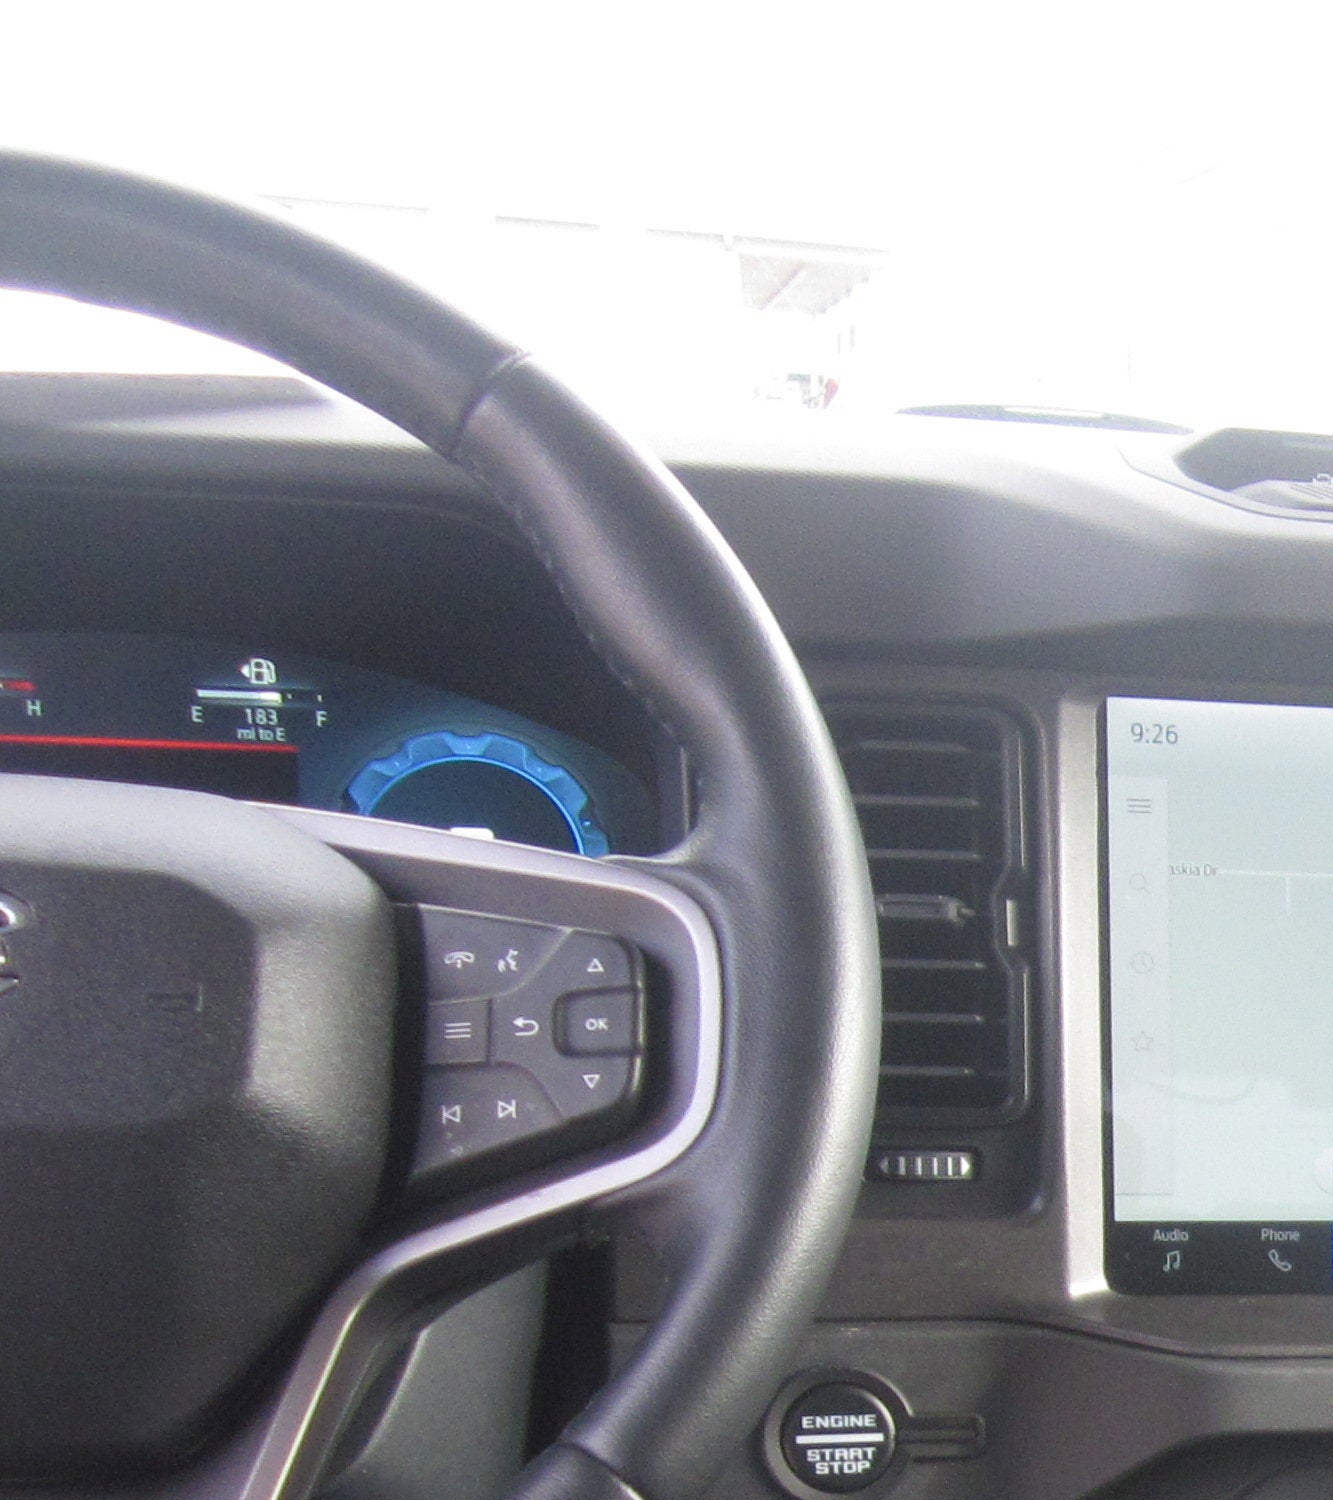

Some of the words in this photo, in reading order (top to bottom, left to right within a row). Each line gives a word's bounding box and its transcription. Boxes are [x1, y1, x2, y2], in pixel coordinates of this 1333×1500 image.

[26, 699, 42, 717] H
[191, 706, 203, 723] E
[245, 708, 278, 726] 183
[315, 710, 327, 727] F
[237, 728, 256, 740] mi
[258, 729, 273, 741] to
[276, 727, 286, 742] E
[1130, 722, 1178, 744] 9:26
[585, 1017, 609, 1031] OK
[1153, 1228, 1189, 1241] Audio
[1261, 1228, 1300, 1241] Phone
[801, 1414, 877, 1429] ENGINE
[806, 1446, 877, 1462] START
[815, 1460, 870, 1475] STOP
